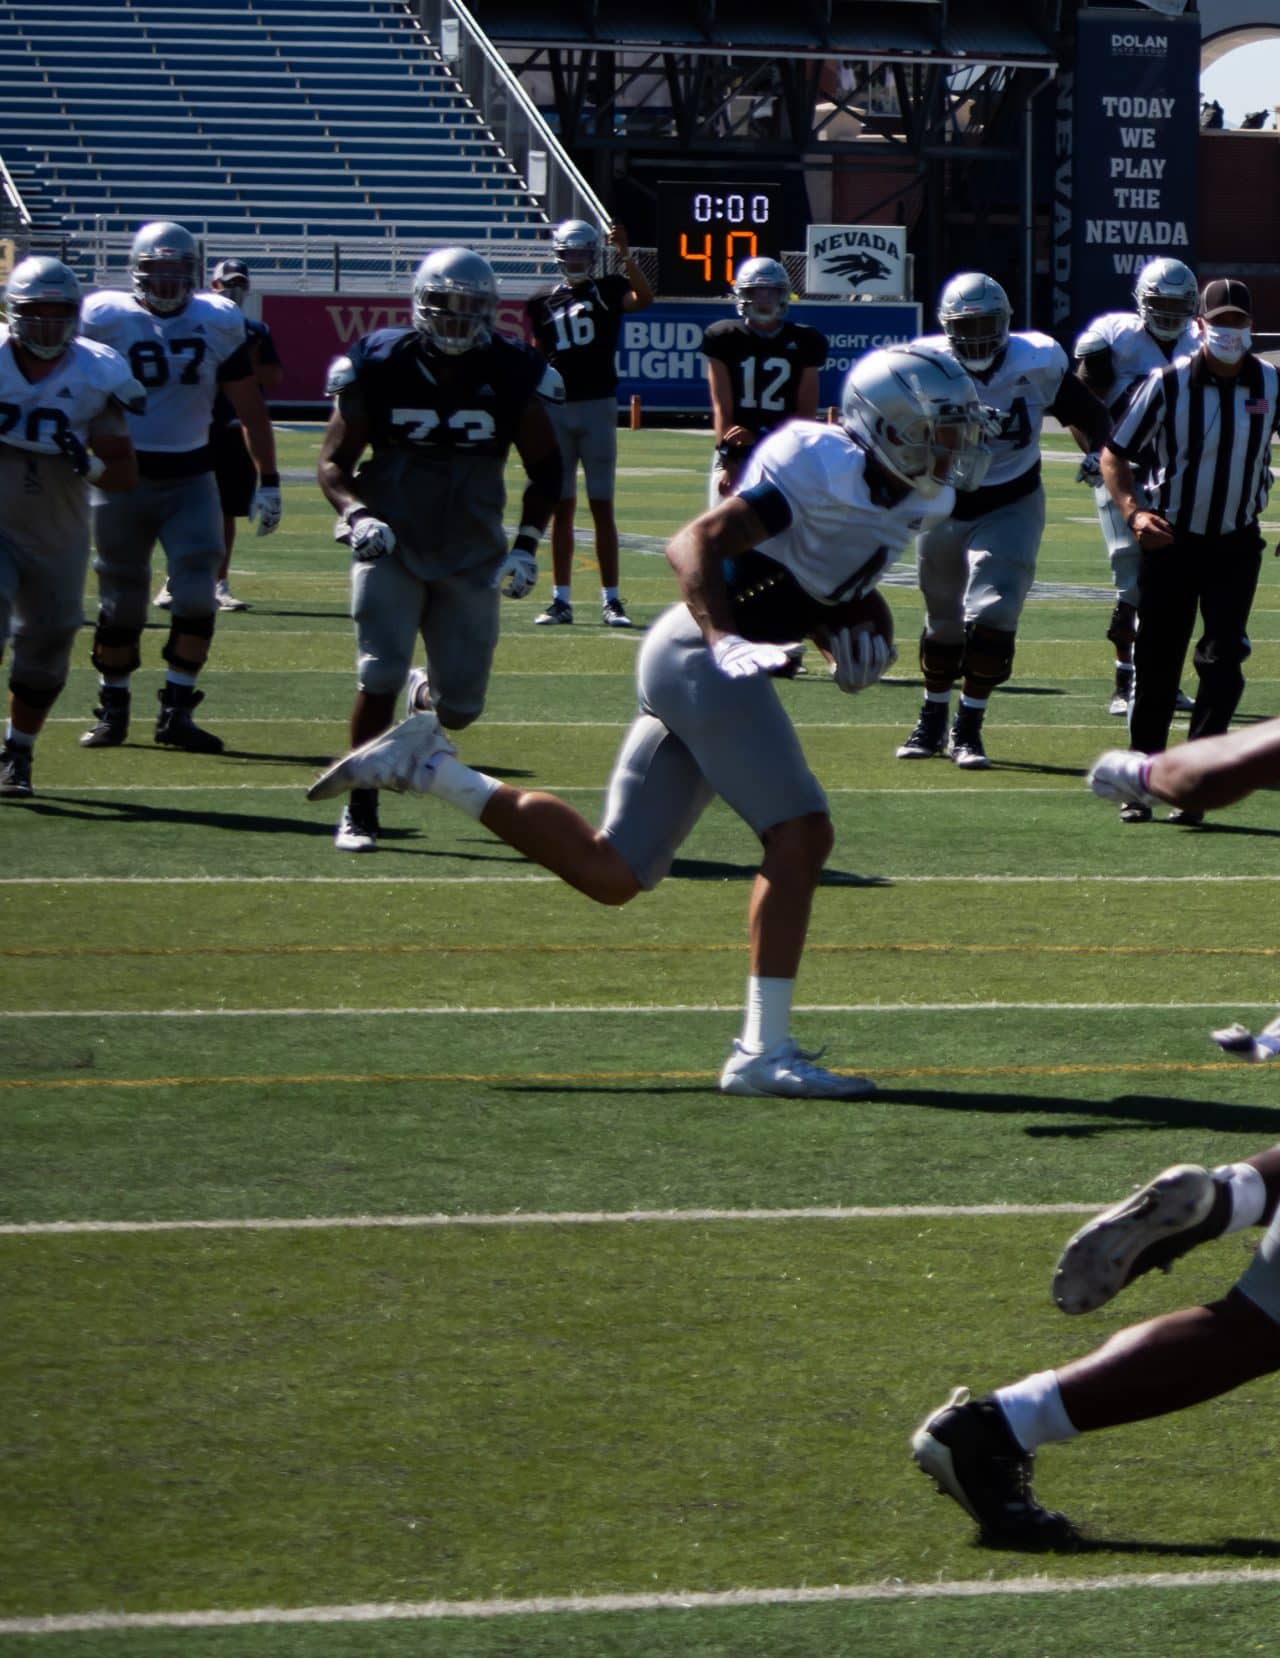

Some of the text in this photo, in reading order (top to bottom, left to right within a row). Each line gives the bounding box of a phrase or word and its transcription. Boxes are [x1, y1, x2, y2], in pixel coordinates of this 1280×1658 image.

[1111, 35, 1168, 48] DOLAN
[1102, 96, 1176, 119] TODAY
[1120, 127, 1156, 148] WE
[1110, 157, 1167, 179] PLAY
[695, 194, 769, 223] 0:00
[1053, 71, 1073, 324] NEVADA
[1114, 188, 1161, 209] THE
[813, 231, 900, 261] NEVADA
[1085, 219, 1190, 245] NEVADA
[680, 231, 758, 286] 40
[550, 300, 596, 351] 16
[624, 321, 704, 350] BUD
[129, 337, 208, 387] 87
[614, 350, 709, 380] LIGHT
[738, 356, 792, 412] 12
